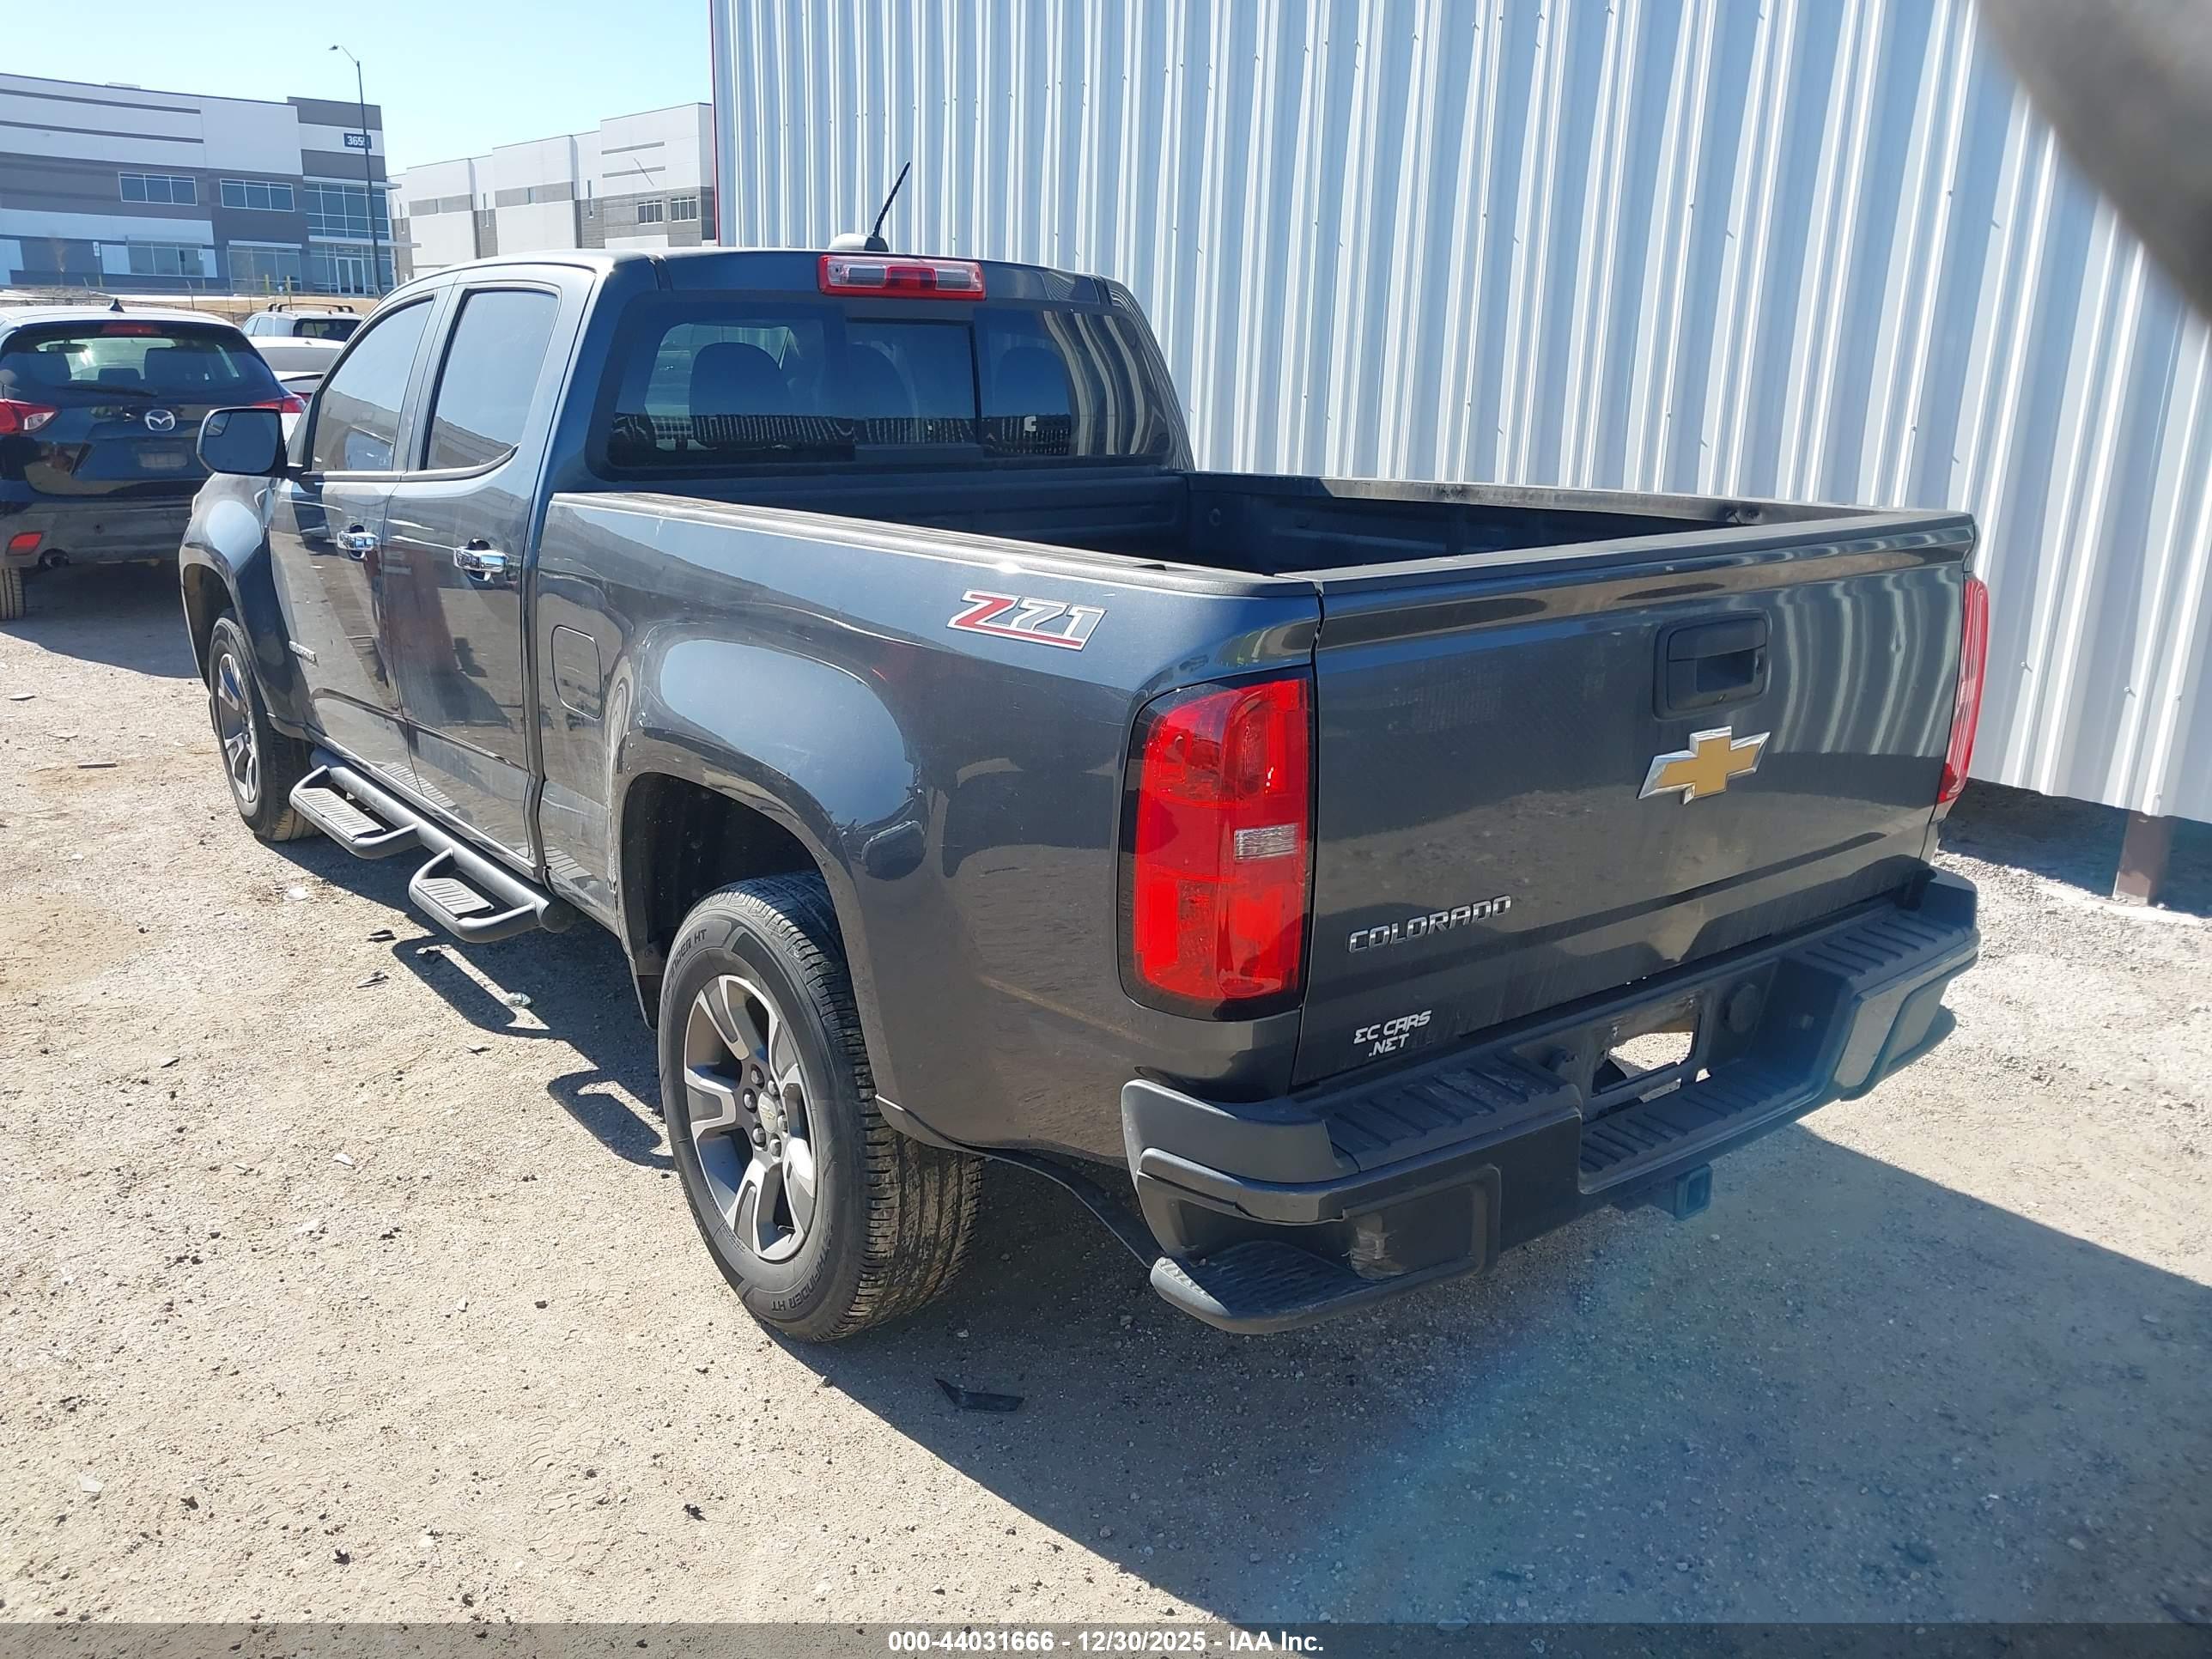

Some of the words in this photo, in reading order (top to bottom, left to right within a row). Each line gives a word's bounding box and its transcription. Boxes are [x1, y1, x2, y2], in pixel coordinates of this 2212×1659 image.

[946, 588, 1108, 652] Z71
[1347, 895, 1511, 953] COLORADO
[1353, 1024, 1381, 1044] EC
[1383, 1010, 1432, 1036] CARS
[1368, 1033, 1410, 1057] .NET
